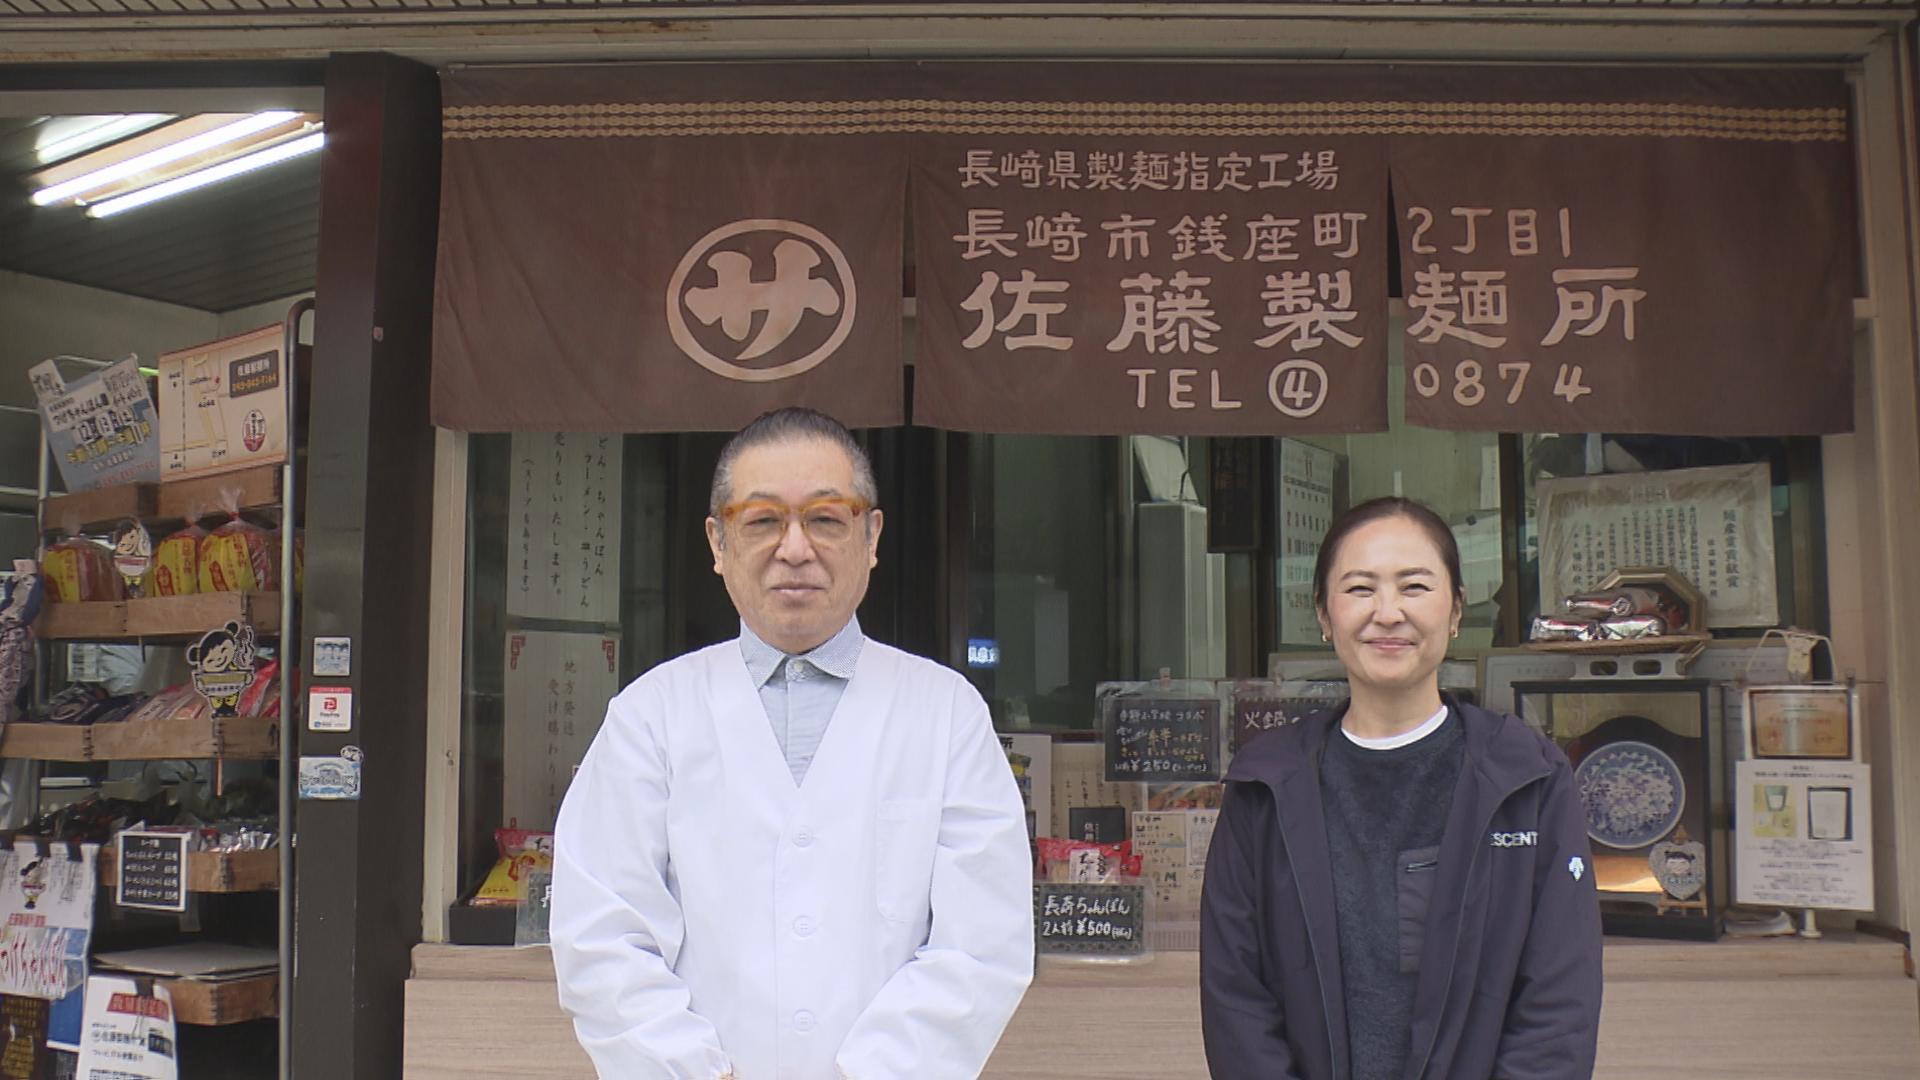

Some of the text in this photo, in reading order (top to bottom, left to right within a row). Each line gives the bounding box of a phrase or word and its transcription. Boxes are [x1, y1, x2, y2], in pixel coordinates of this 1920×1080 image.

[683, 238, 841, 361] サ
[958, 264, 1648, 353] 佐藤製麺所
[1126, 369, 1242, 410] TEL
[1490, 830, 1539, 848] SCENT
